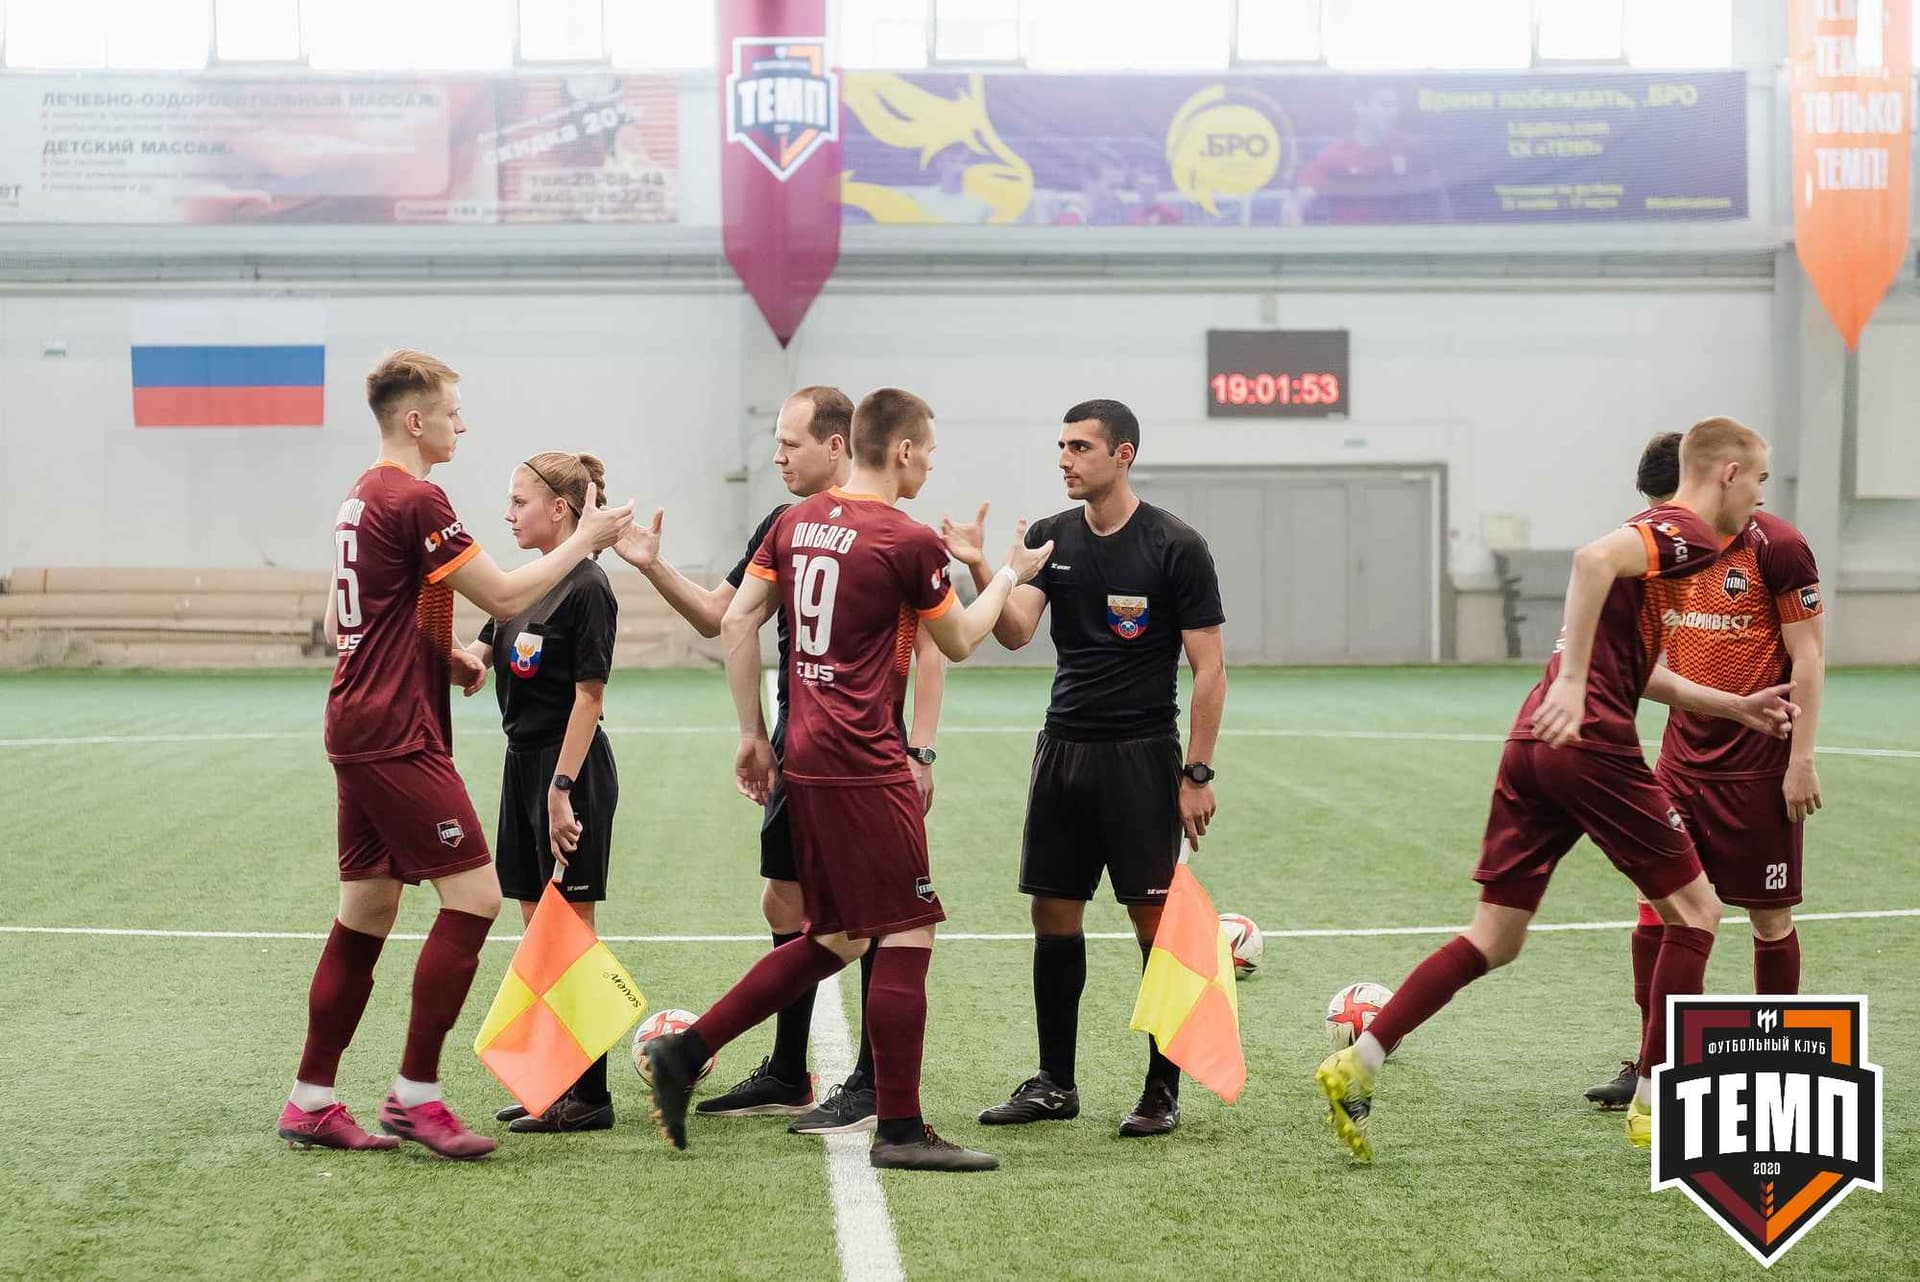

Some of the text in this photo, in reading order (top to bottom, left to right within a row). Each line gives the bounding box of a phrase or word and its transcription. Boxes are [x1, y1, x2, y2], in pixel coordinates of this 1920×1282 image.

[737, 76, 828, 127] ТЕМП
[1802, 91, 1903, 134] ТОЛЬКО
[42, 137, 135, 156] ДЕТСКИЙ
[1198, 132, 1269, 158] .БРО
[1815, 147, 1889, 190] ТЕМП!
[1210, 372, 1340, 405] 19:01:53
[791, 522, 858, 554] ШИБАЕВ
[791, 554, 840, 657] 19
[1765, 862, 1788, 890] 23
